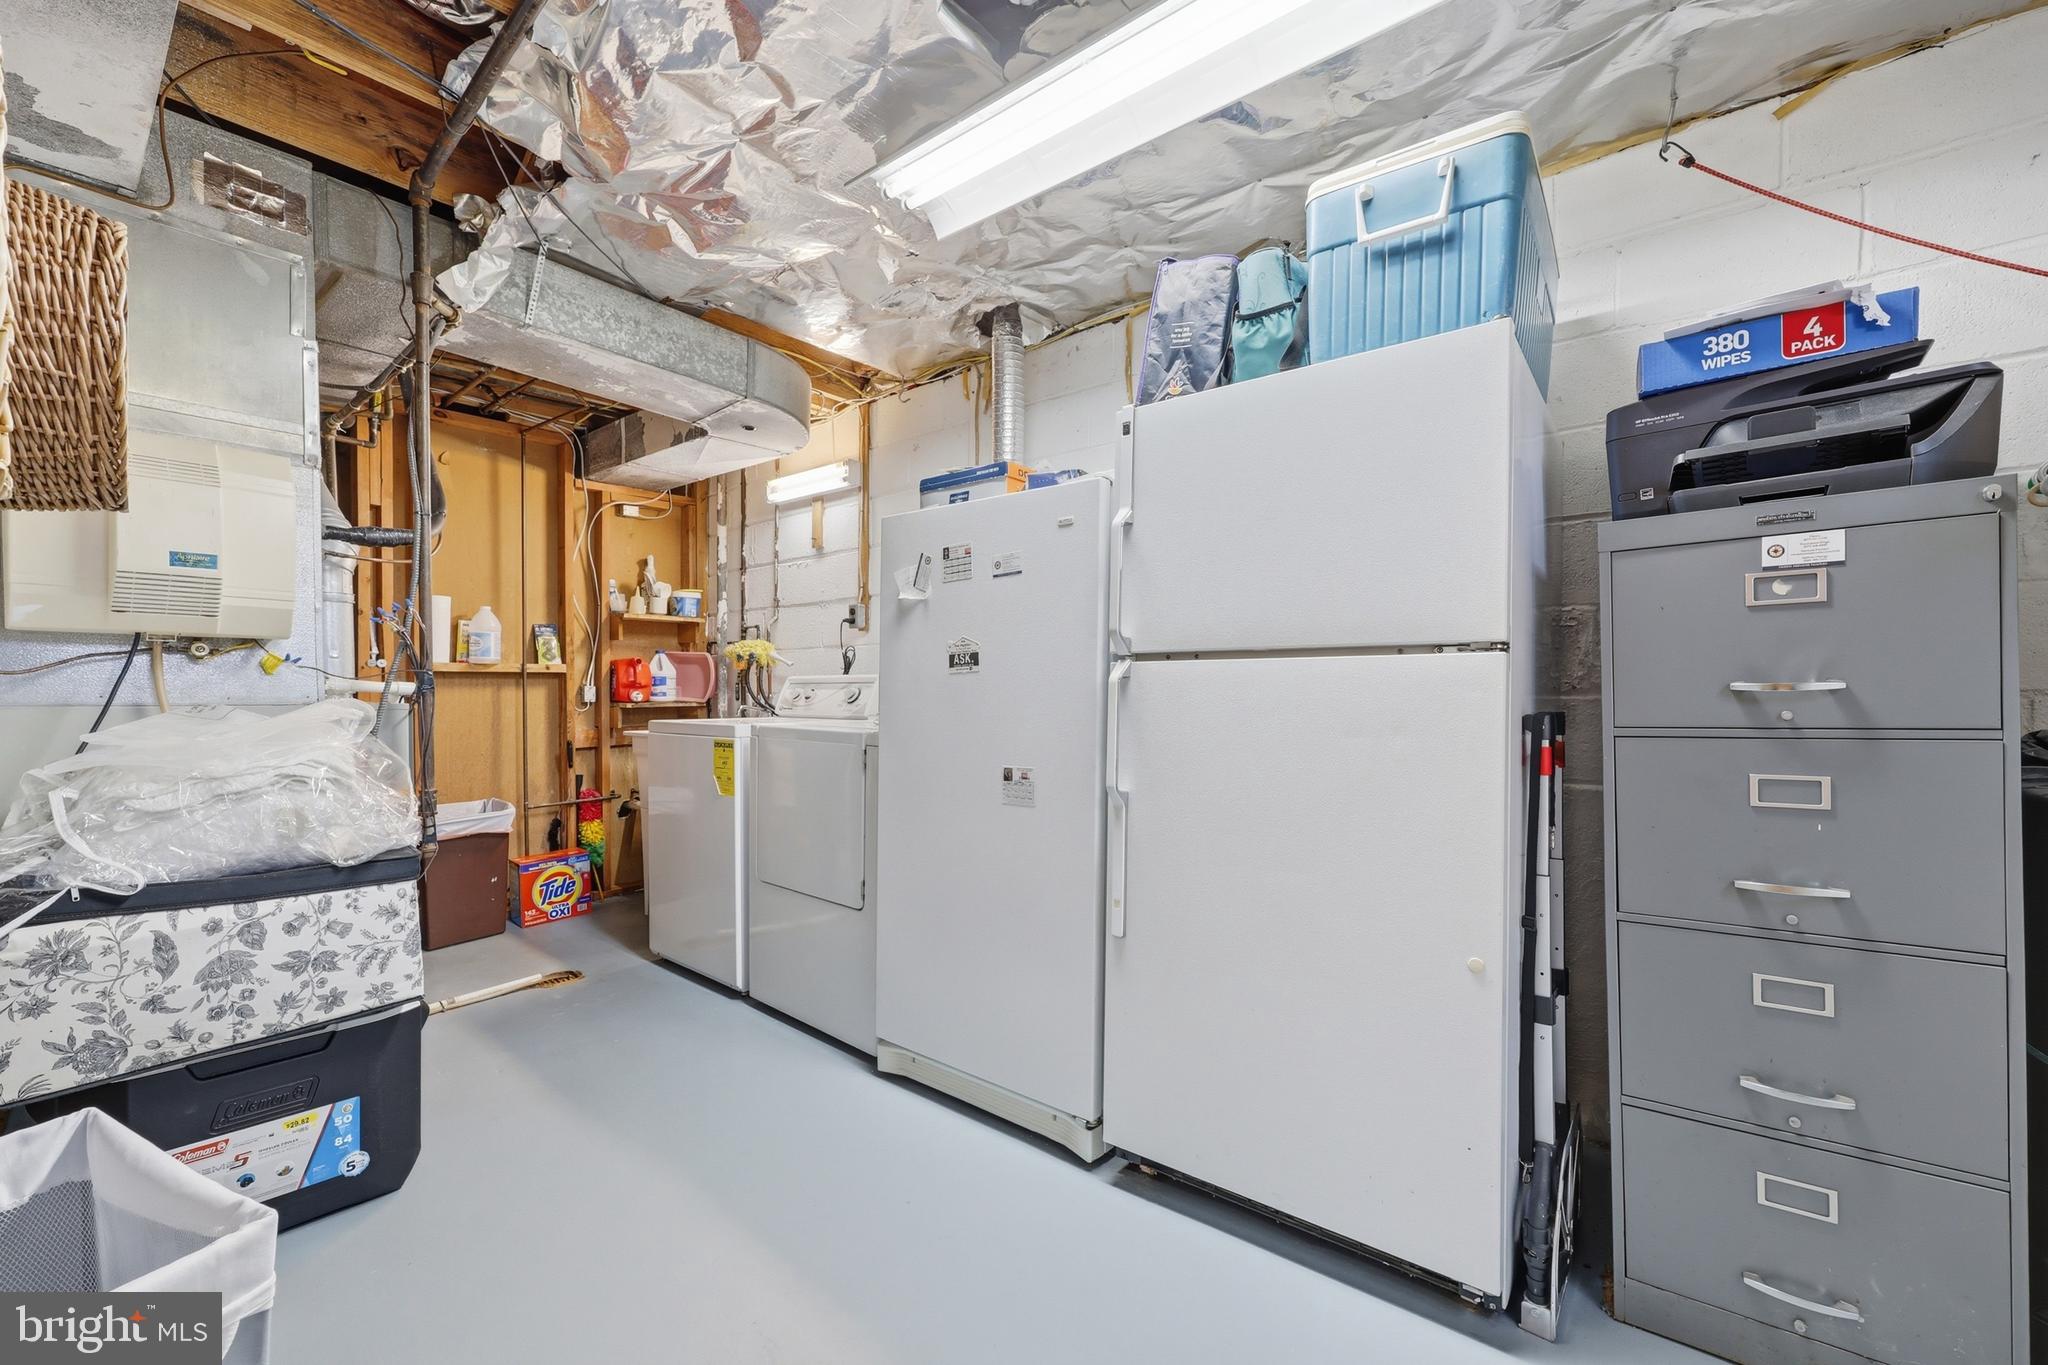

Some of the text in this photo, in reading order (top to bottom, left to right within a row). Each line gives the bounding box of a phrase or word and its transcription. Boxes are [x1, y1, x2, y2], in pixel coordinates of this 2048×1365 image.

[1803, 315, 1823, 337] 4
[1703, 329, 1750, 356] 380
[1791, 333, 1836, 354] PACK
[1701, 350, 1752, 371] WIPES
[953, 653, 974, 665] ASK.
[539, 876, 577, 906] Tide
[549, 906, 571, 918] OXI
[551, 902, 570, 910] ULTRA
[334, 1114, 353, 1126] 50
[334, 1134, 353, 1146] 84
[345, 1160, 356, 1172] 5
